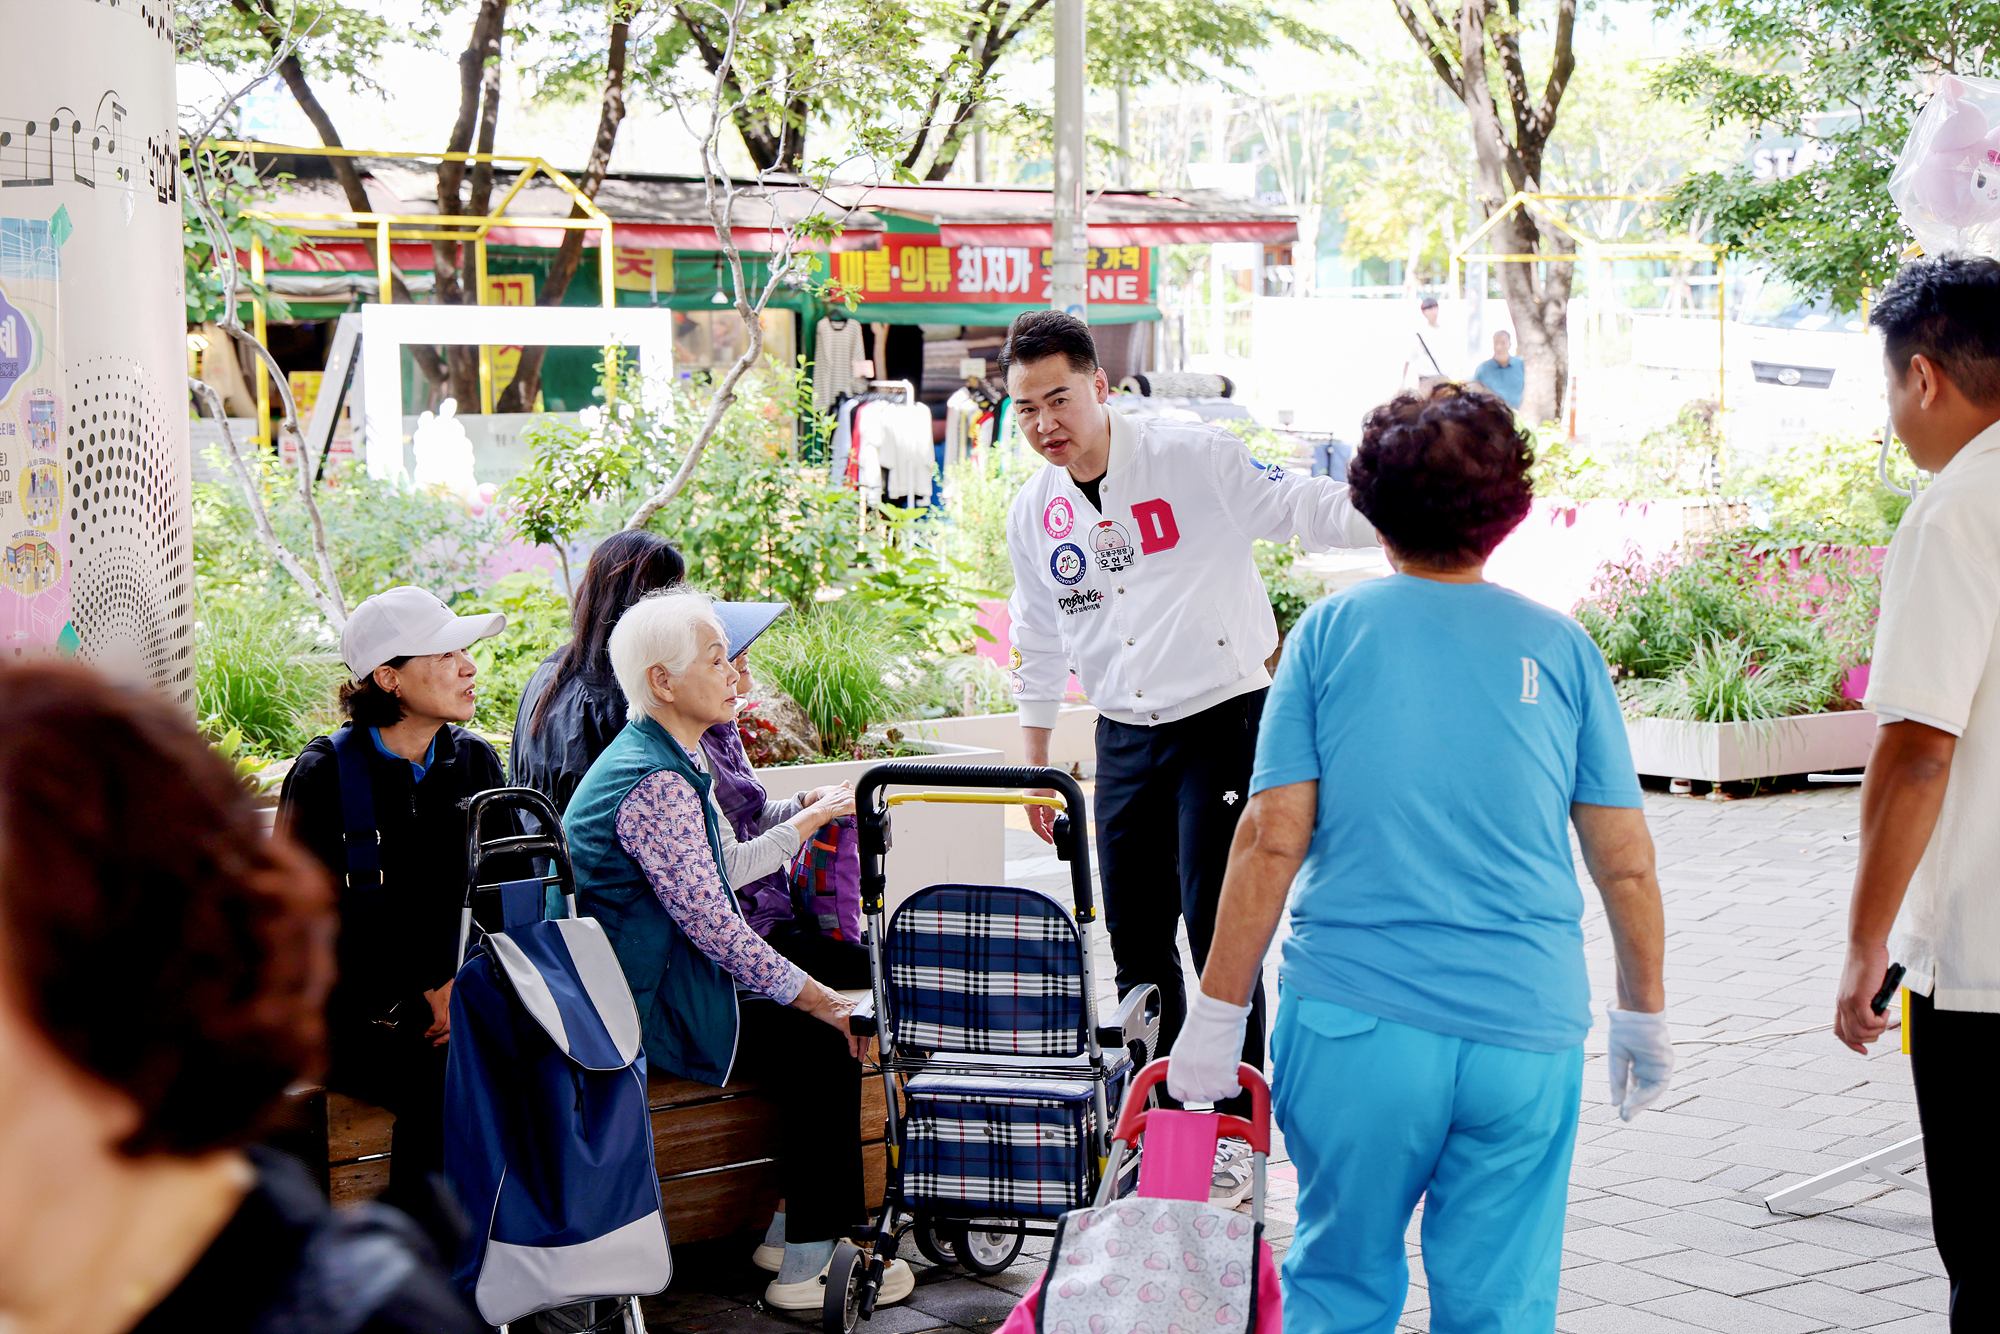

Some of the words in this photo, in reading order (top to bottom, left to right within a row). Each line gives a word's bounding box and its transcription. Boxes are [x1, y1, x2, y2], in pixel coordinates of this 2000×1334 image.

[957, 244, 1034, 294] 최저가
[1102, 246, 1140, 271] 가격
[1041, 274, 1139, 301] ZNE
[1130, 498, 1180, 556] D
[1056, 545, 1072, 554] SEOUL
[1100, 547, 1128, 559] 도봉구청장
[1520, 656, 1540, 699] B
